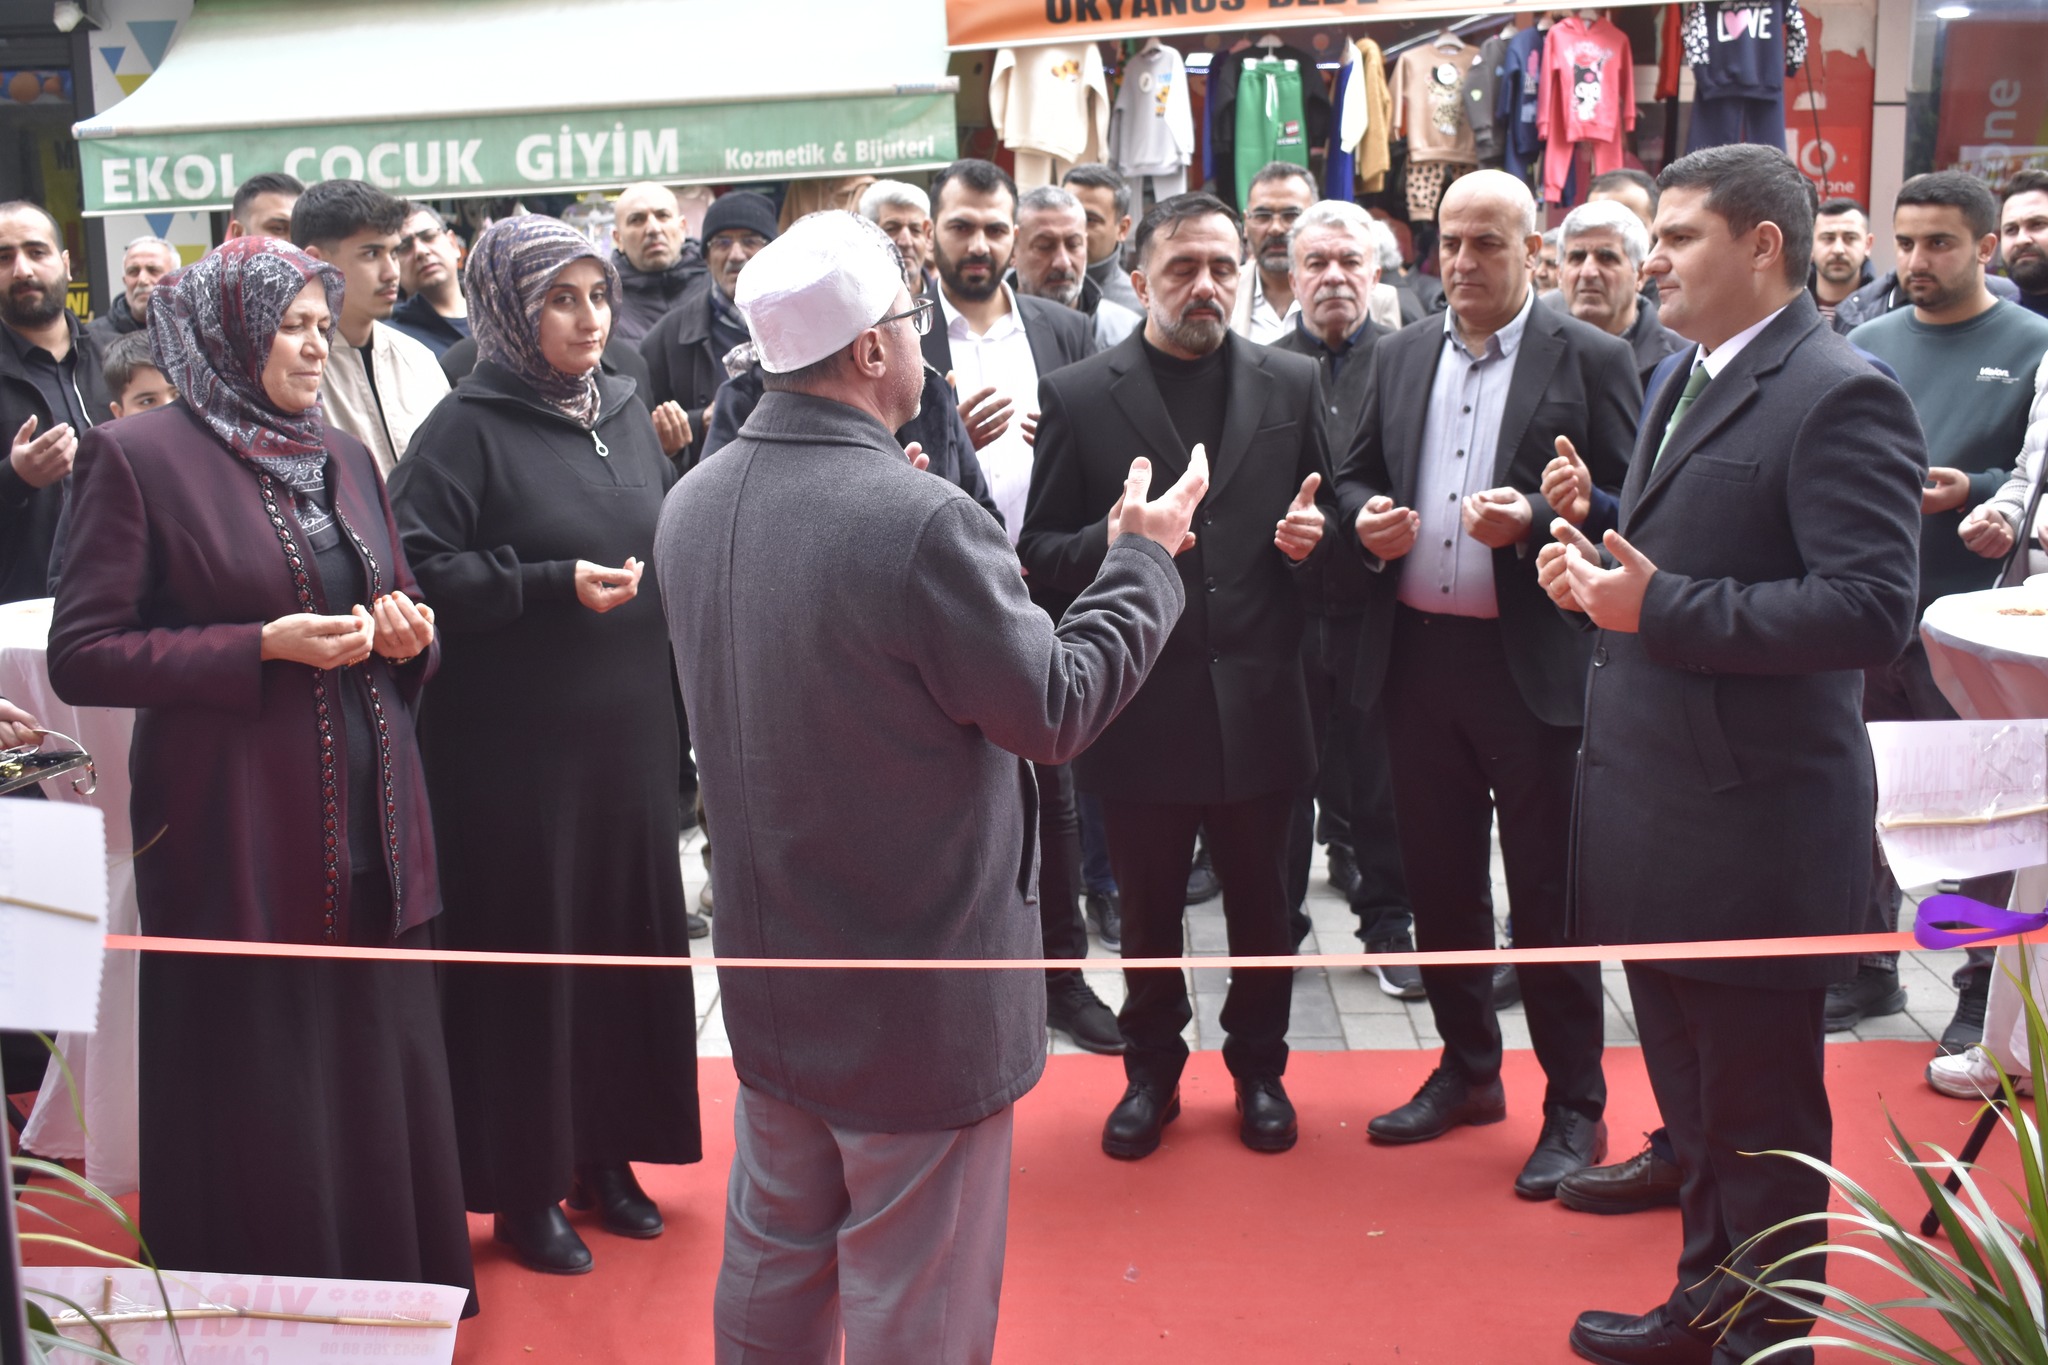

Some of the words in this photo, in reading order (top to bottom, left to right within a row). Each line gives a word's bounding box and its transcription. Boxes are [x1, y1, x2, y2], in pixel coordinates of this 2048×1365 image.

[101, 153, 239, 204] EKOL
[515, 122, 680, 181] GİYİM
[724, 143, 827, 170] Kozmetik
[832, 141, 847, 164] &
[855, 135, 935, 168] Bijuteri
